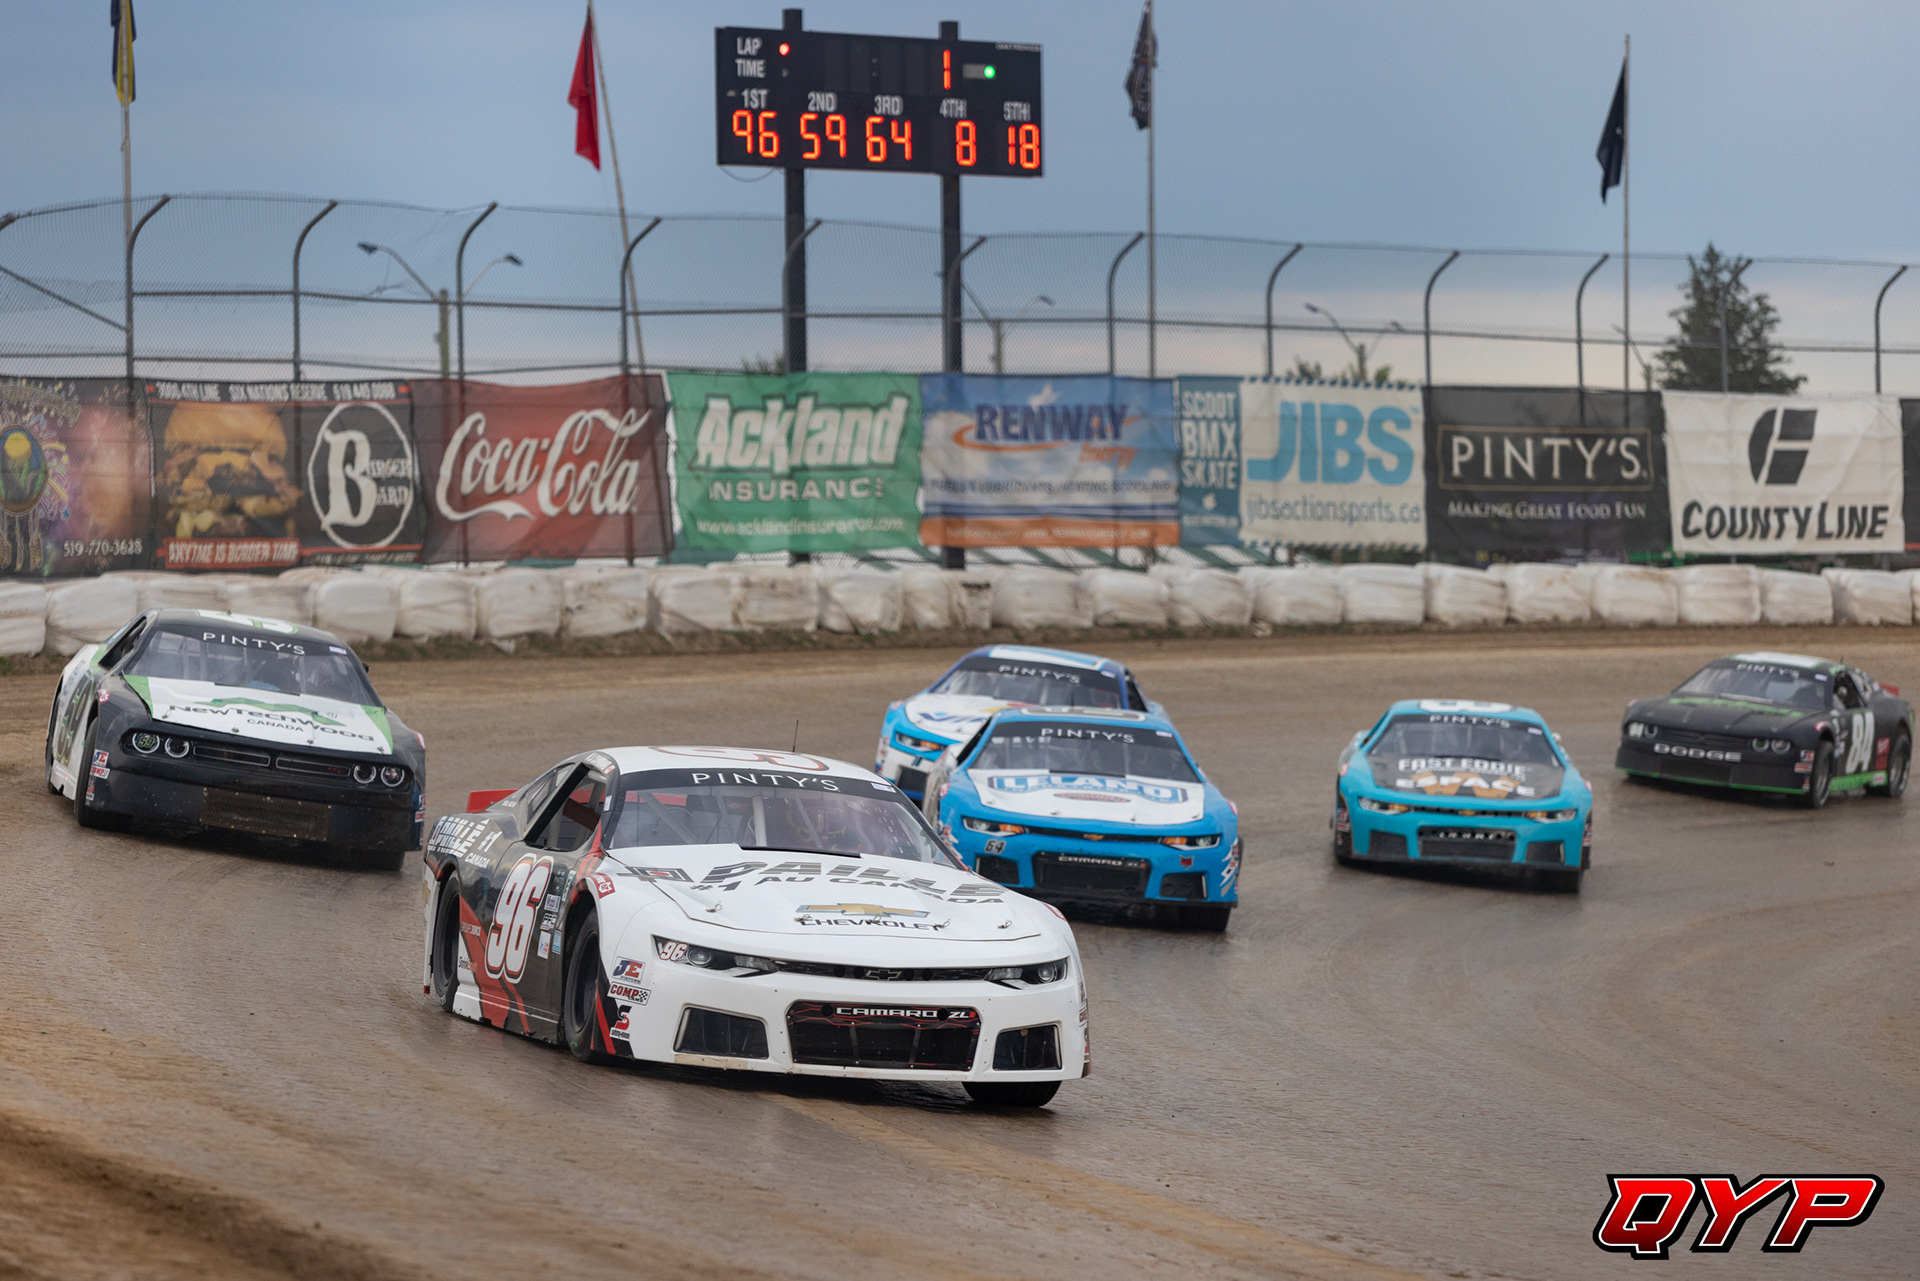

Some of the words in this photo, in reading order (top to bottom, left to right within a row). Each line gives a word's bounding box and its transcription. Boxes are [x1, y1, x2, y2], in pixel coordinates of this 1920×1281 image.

[736, 37, 762, 56] LAP
[735, 58, 766, 79] TIME
[942, 49, 951, 91] 1
[741, 89, 768, 110] 1ST
[807, 92, 838, 113] 2ND
[873, 96, 903, 116] 3RD
[938, 98, 967, 120] 4TH
[1003, 102, 1031, 122] 5TH
[732, 109, 780, 159] 96
[799, 112, 847, 160] 59
[865, 116, 912, 164] 64
[955, 120, 977, 167] 8
[1007, 123, 1040, 170] 18
[1182, 391, 1236, 419] SCOOT
[974, 404, 1129, 440] RENWAY
[693, 394, 911, 475] Ackland
[1181, 420, 1238, 459] BMX
[1247, 402, 1414, 486] JIBS
[436, 407, 650, 522] Coca-Cola
[1451, 435, 1645, 480] PINTY'S
[1181, 459, 1238, 490] SKATE
[1246, 491, 1422, 528] jibsactionsports.ca
[203, 631, 306, 656] PINTY'S
[998, 664, 1081, 685] PINTY'S
[1736, 662, 1801, 679] PINTY'S
[247, 718, 304, 732] CANADA
[1430, 714, 1511, 729] PINTY'S
[1041, 727, 1135, 744] PINTY'S
[1845, 710, 1875, 774] 84
[1653, 743, 1742, 763] DODGE
[1398, 758, 1456, 772] FAST
[1460, 758, 1526, 777] EDDIE
[691, 772, 841, 792] PINTY'S
[1001, 776, 1173, 800] LELAND
[1395, 775, 1536, 797] ESPACE
[985, 839, 1006, 855] 64
[464, 852, 490, 869] CANADA
[1058, 856, 1122, 866] CAMARO
[754, 876, 815, 887] AU
[828, 877, 1005, 903] CANADA
[484, 853, 554, 984] 96
[799, 918, 941, 931] CHEVROLET
[659, 940, 689, 962] 96
[612, 960, 643, 978] JE
[610, 984, 640, 998] COMP
[836, 1007, 938, 1018] CAMARO
